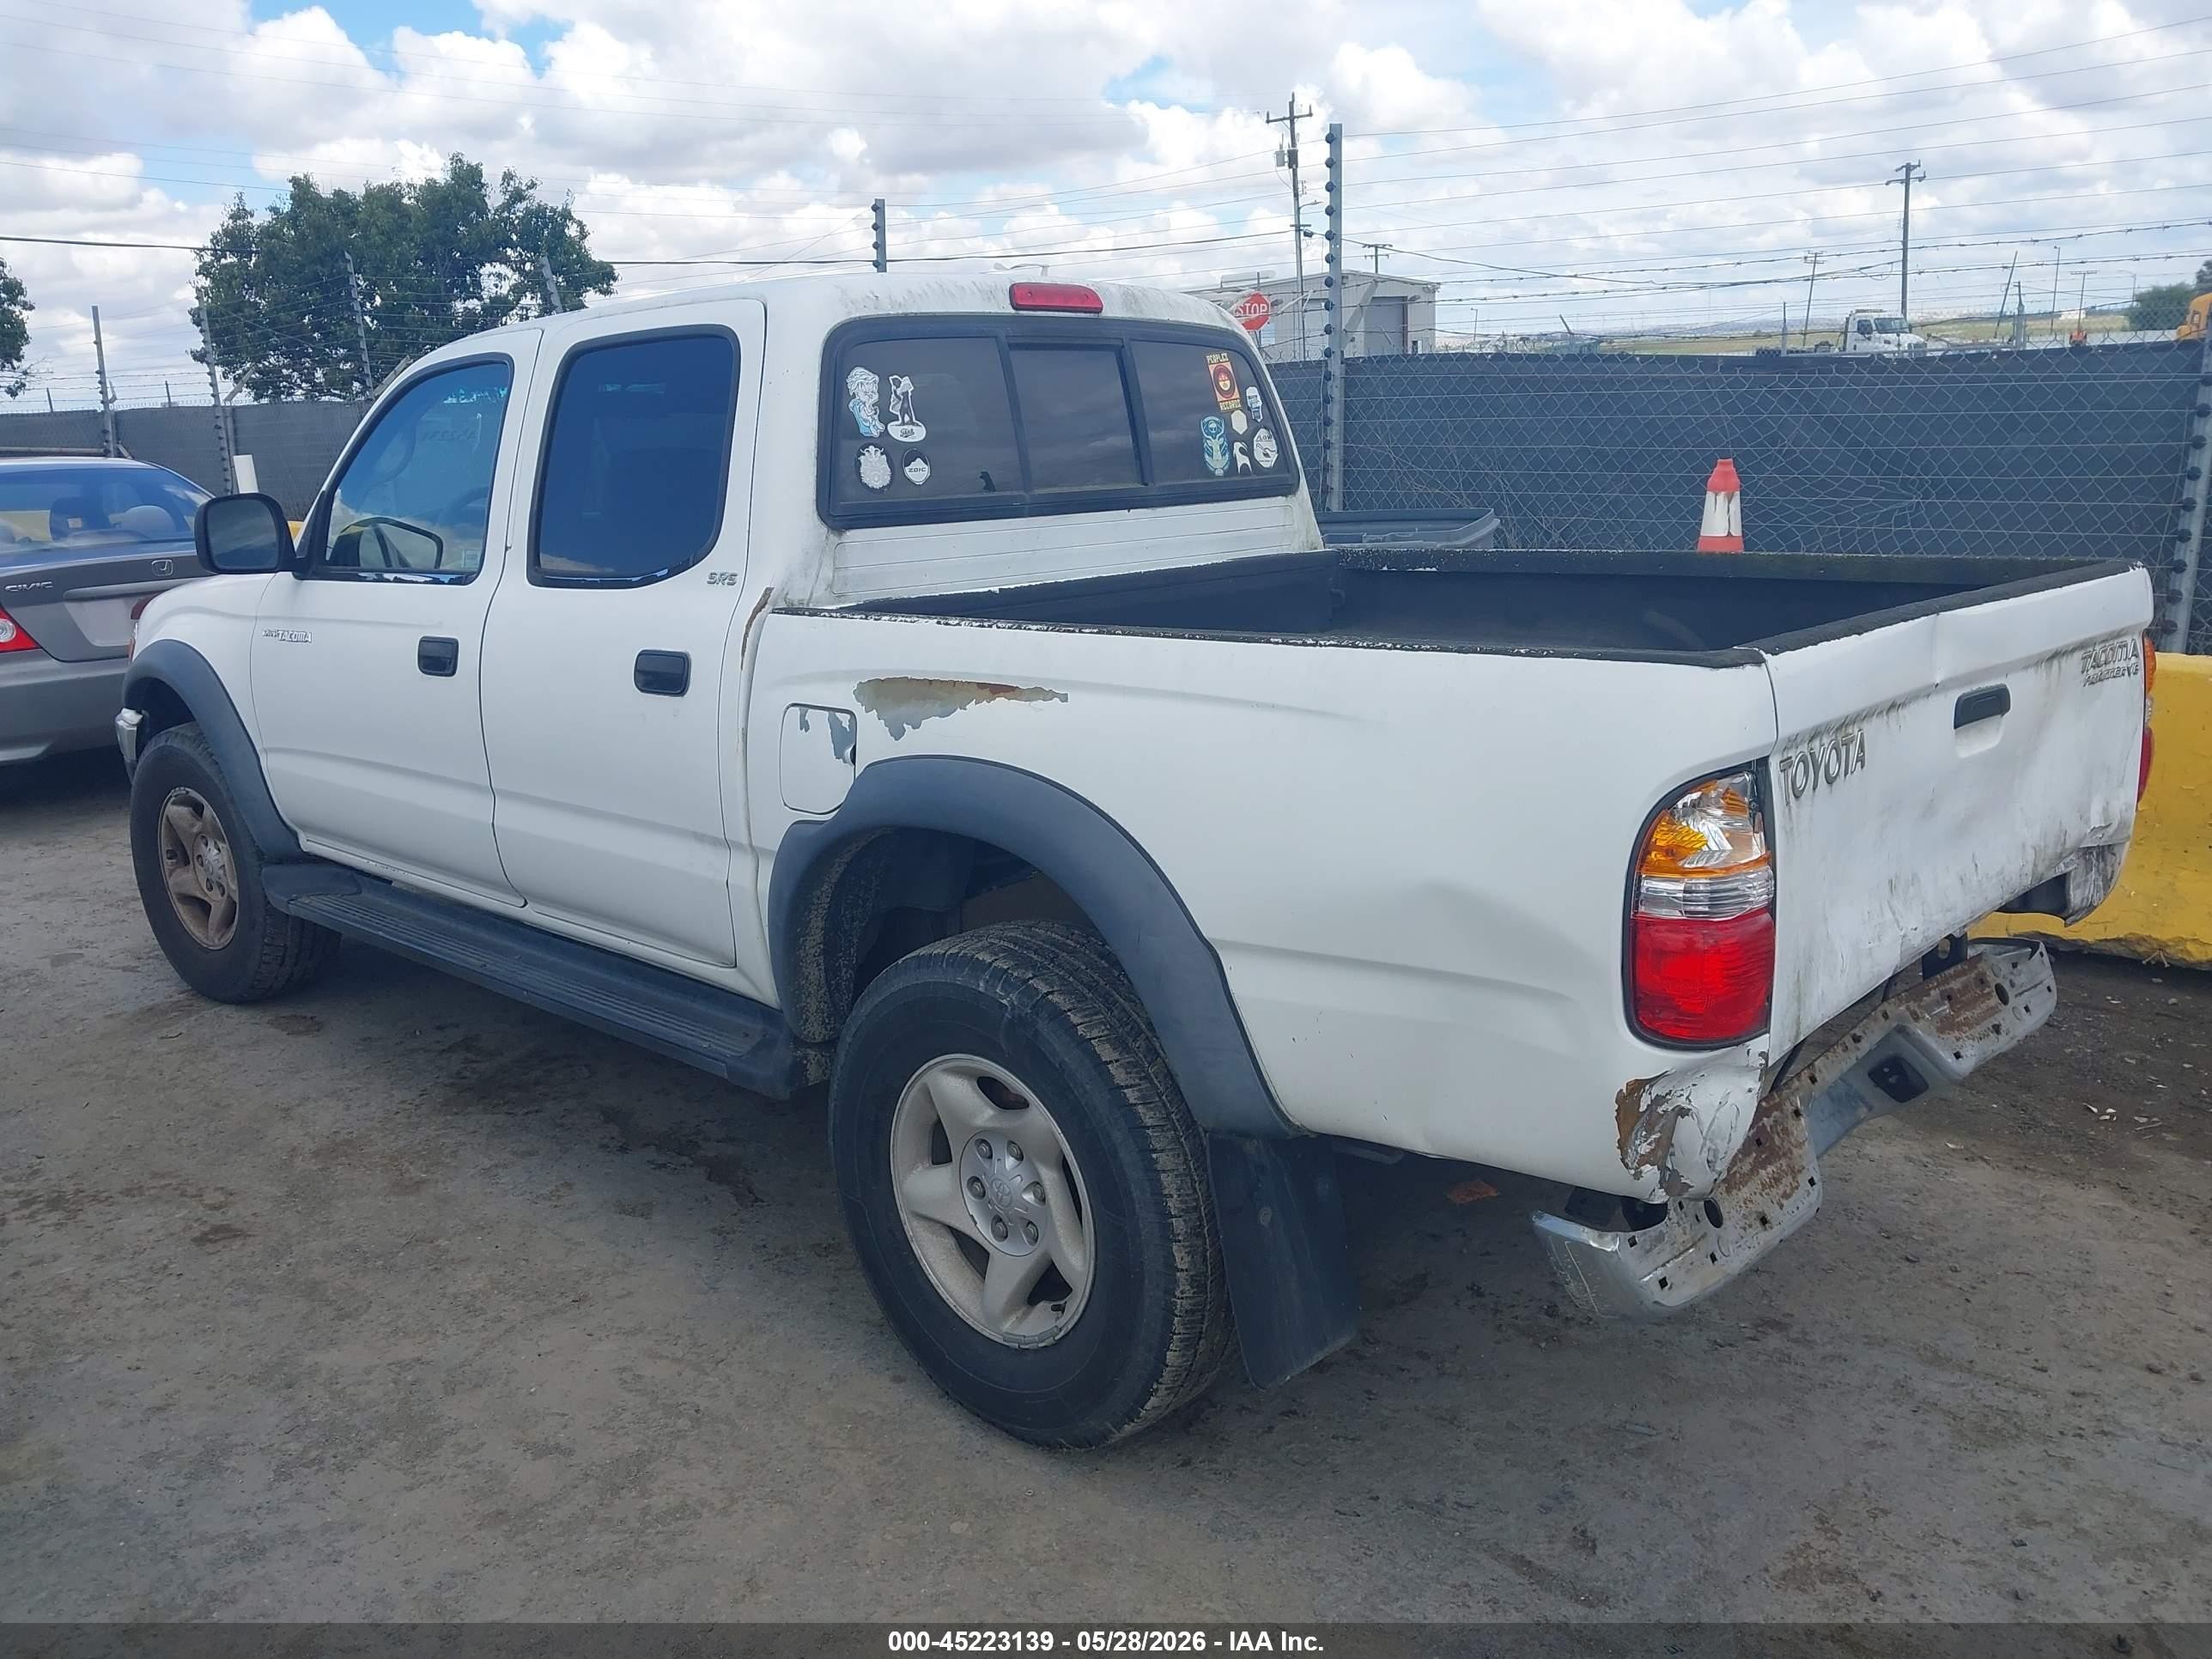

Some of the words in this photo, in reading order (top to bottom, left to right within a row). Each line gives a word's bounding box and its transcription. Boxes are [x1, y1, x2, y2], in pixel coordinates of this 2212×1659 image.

[1234, 302, 1268, 316] STOP
[5, 581, 54, 592] CIVIC
[278, 629, 313, 643] TACOMA
[2081, 640, 2139, 674] TACOMA
[1779, 729, 1866, 805] TOYOTA
